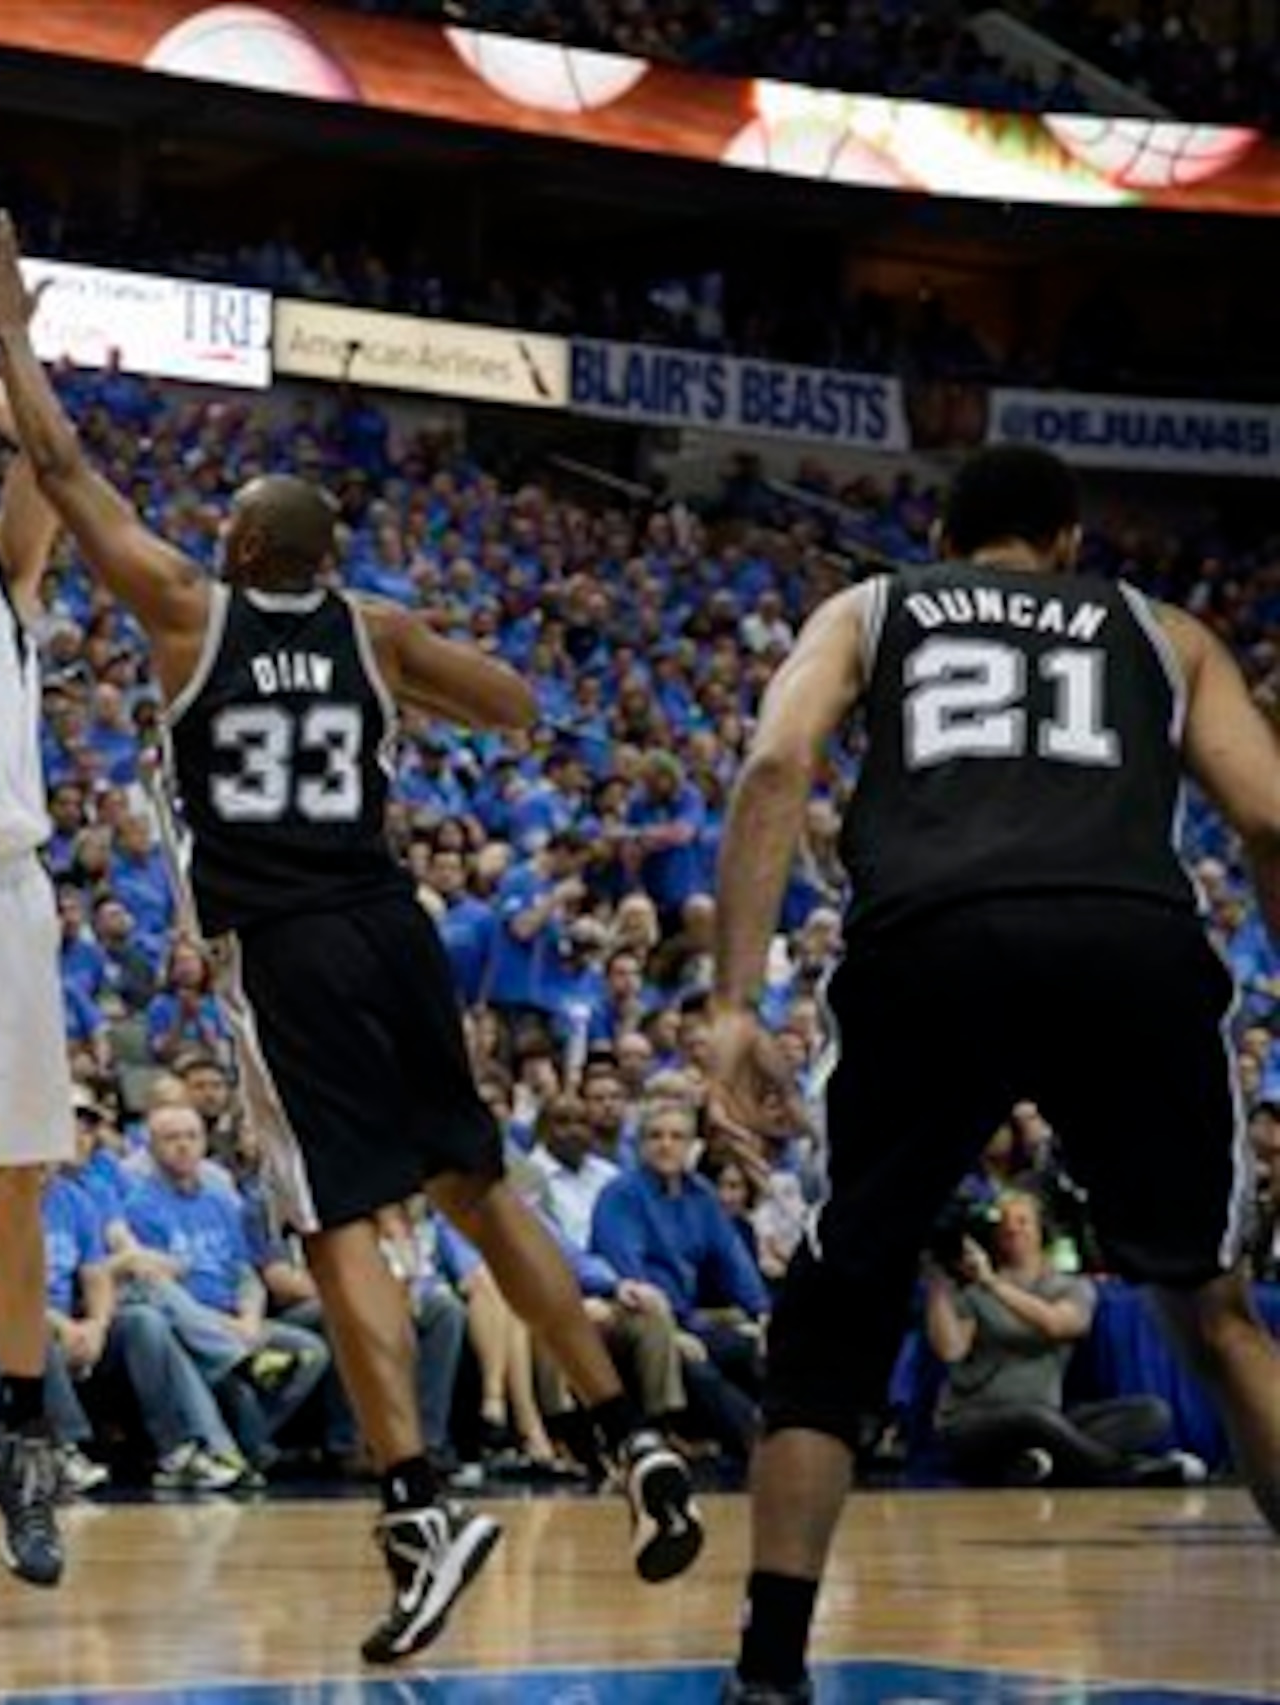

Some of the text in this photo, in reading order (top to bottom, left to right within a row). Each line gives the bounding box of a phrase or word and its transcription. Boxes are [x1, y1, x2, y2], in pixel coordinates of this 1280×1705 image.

[290, 324, 408, 365] Amecan
[571, 345, 888, 441] BLAIR'S BEASTS
[999, 403, 1271, 456] @DEJUAN45
[905, 586, 1108, 641] DUNCAN
[251, 650, 334, 694] DIAW
[902, 637, 1123, 772] 21
[209, 704, 363, 822] 33
